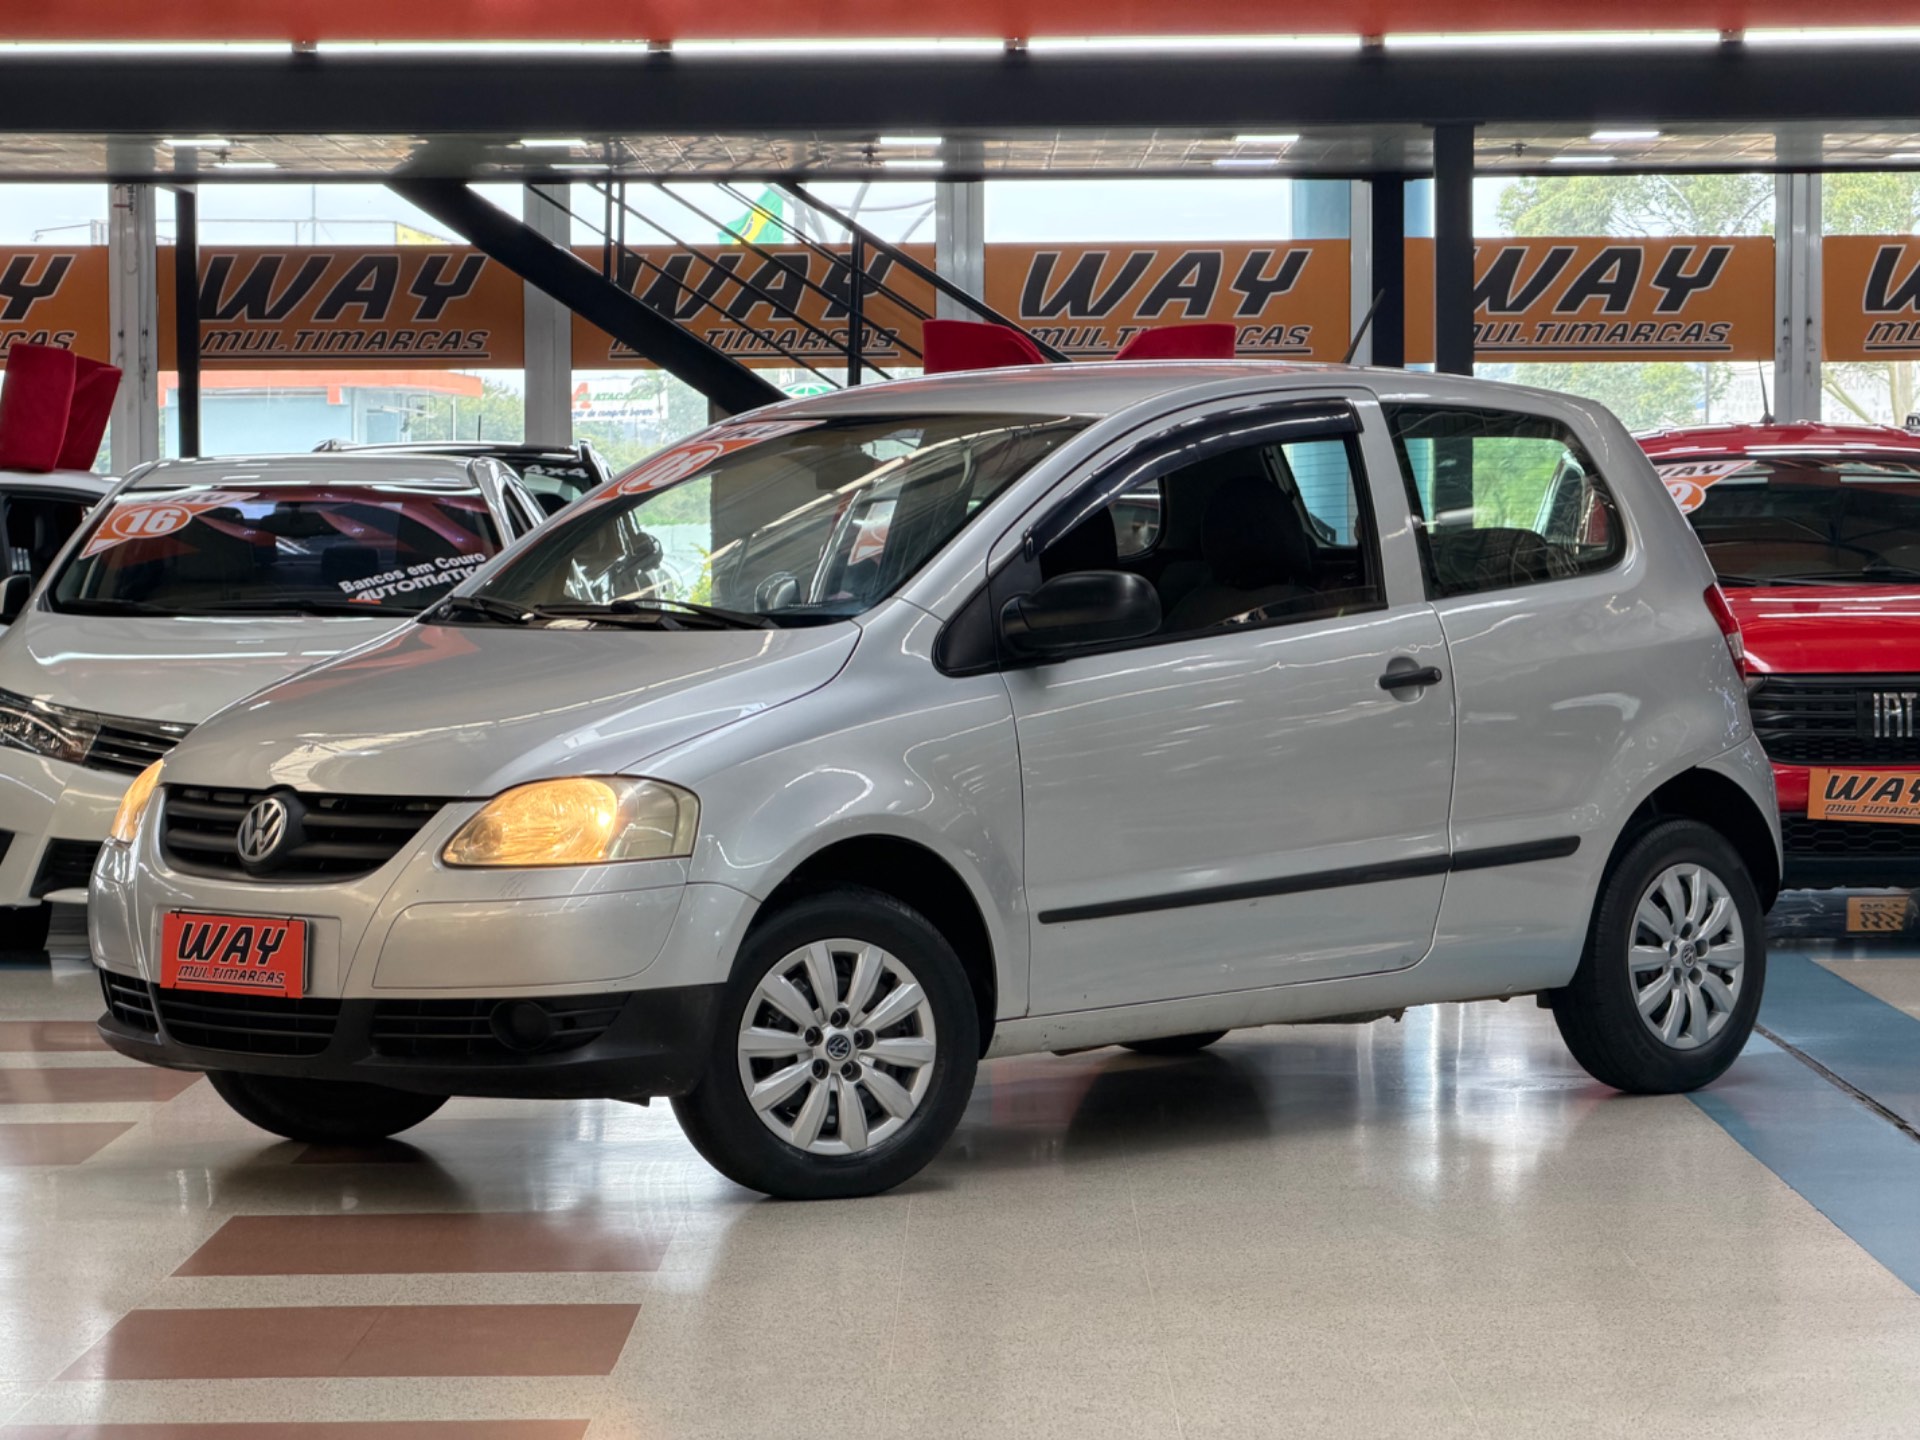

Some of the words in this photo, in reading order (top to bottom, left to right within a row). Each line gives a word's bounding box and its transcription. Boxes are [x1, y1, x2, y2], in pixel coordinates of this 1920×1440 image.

[200, 253, 488, 322] WAY
[1019, 249, 1312, 319] WAY
[201, 329, 491, 351] MULTIMARCAS
[125, 509, 182, 533] 16
[338, 568, 405, 593] Bancos
[407, 563, 434, 576] em
[435, 553, 486, 570] Couro
[177, 922, 288, 966] WAY
[178, 965, 285, 984] MULTIMARCAS
